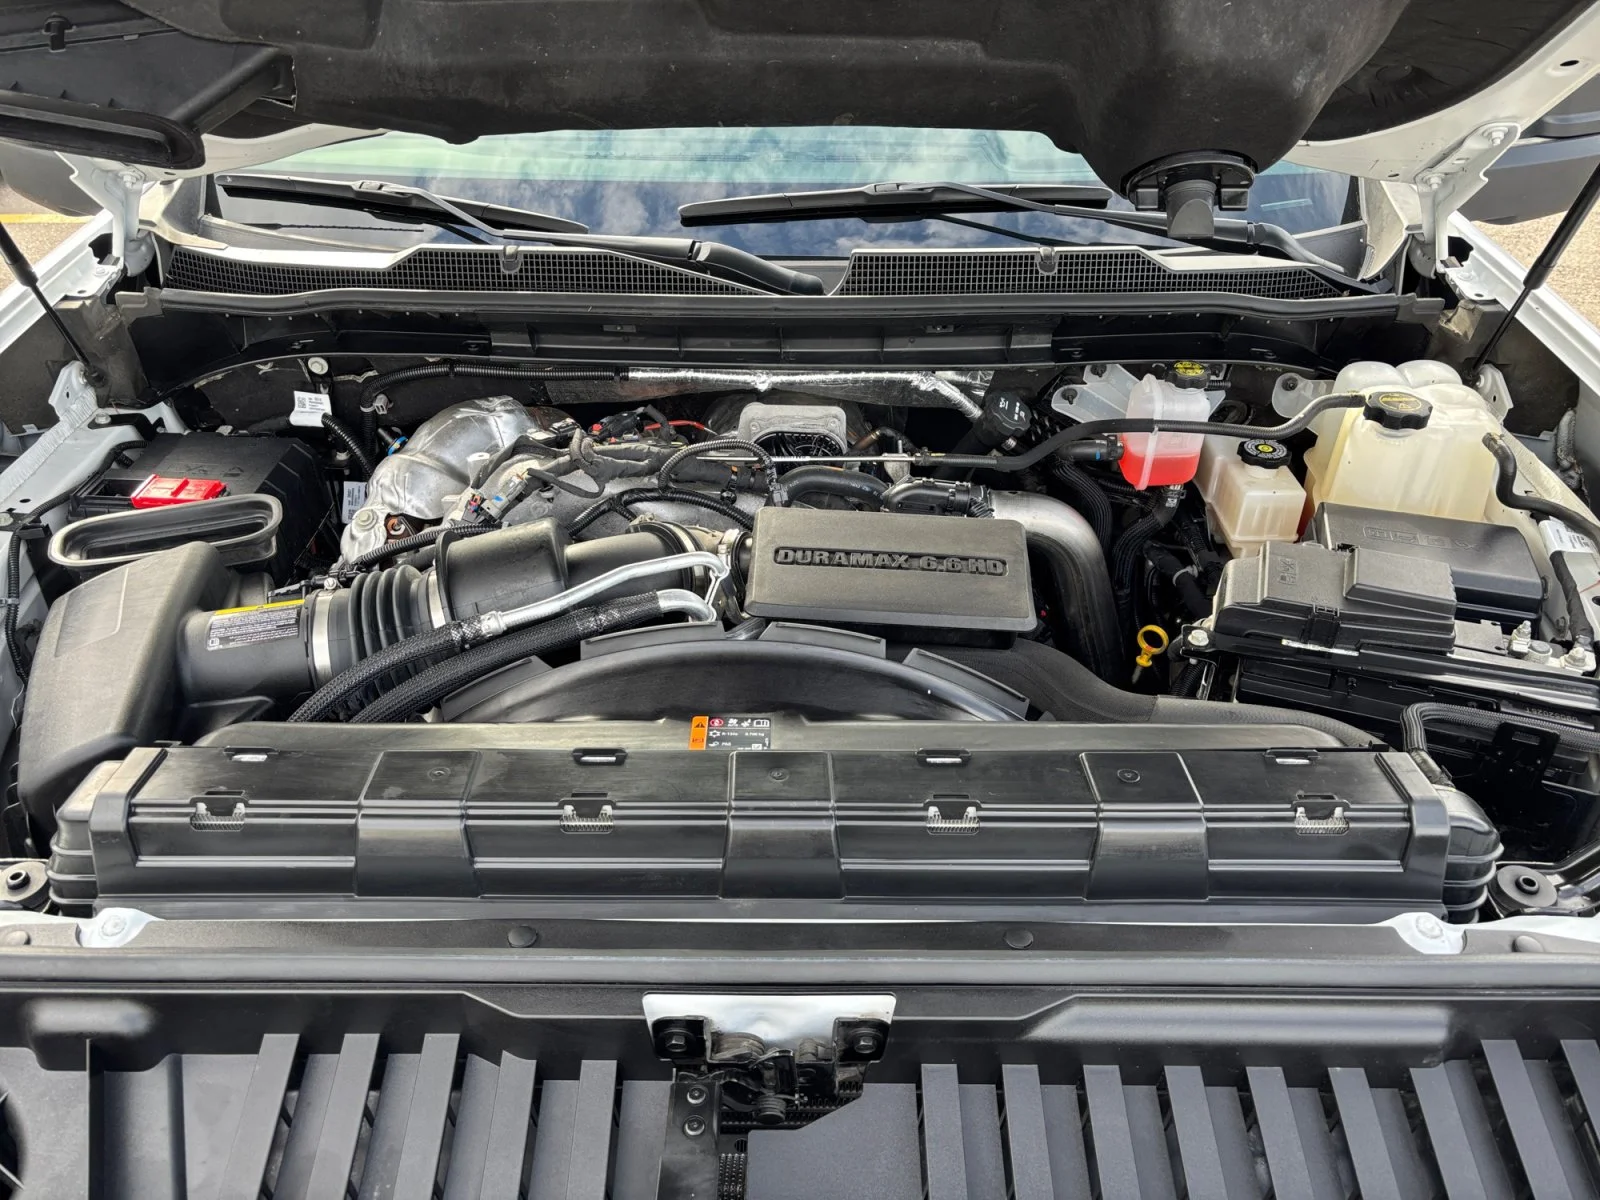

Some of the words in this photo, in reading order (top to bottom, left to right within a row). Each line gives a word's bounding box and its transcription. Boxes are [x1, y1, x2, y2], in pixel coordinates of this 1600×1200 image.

[776, 549, 909, 568] DURAMAX
[919, 555, 962, 572] 6.6
[968, 558, 1005, 575] HD
